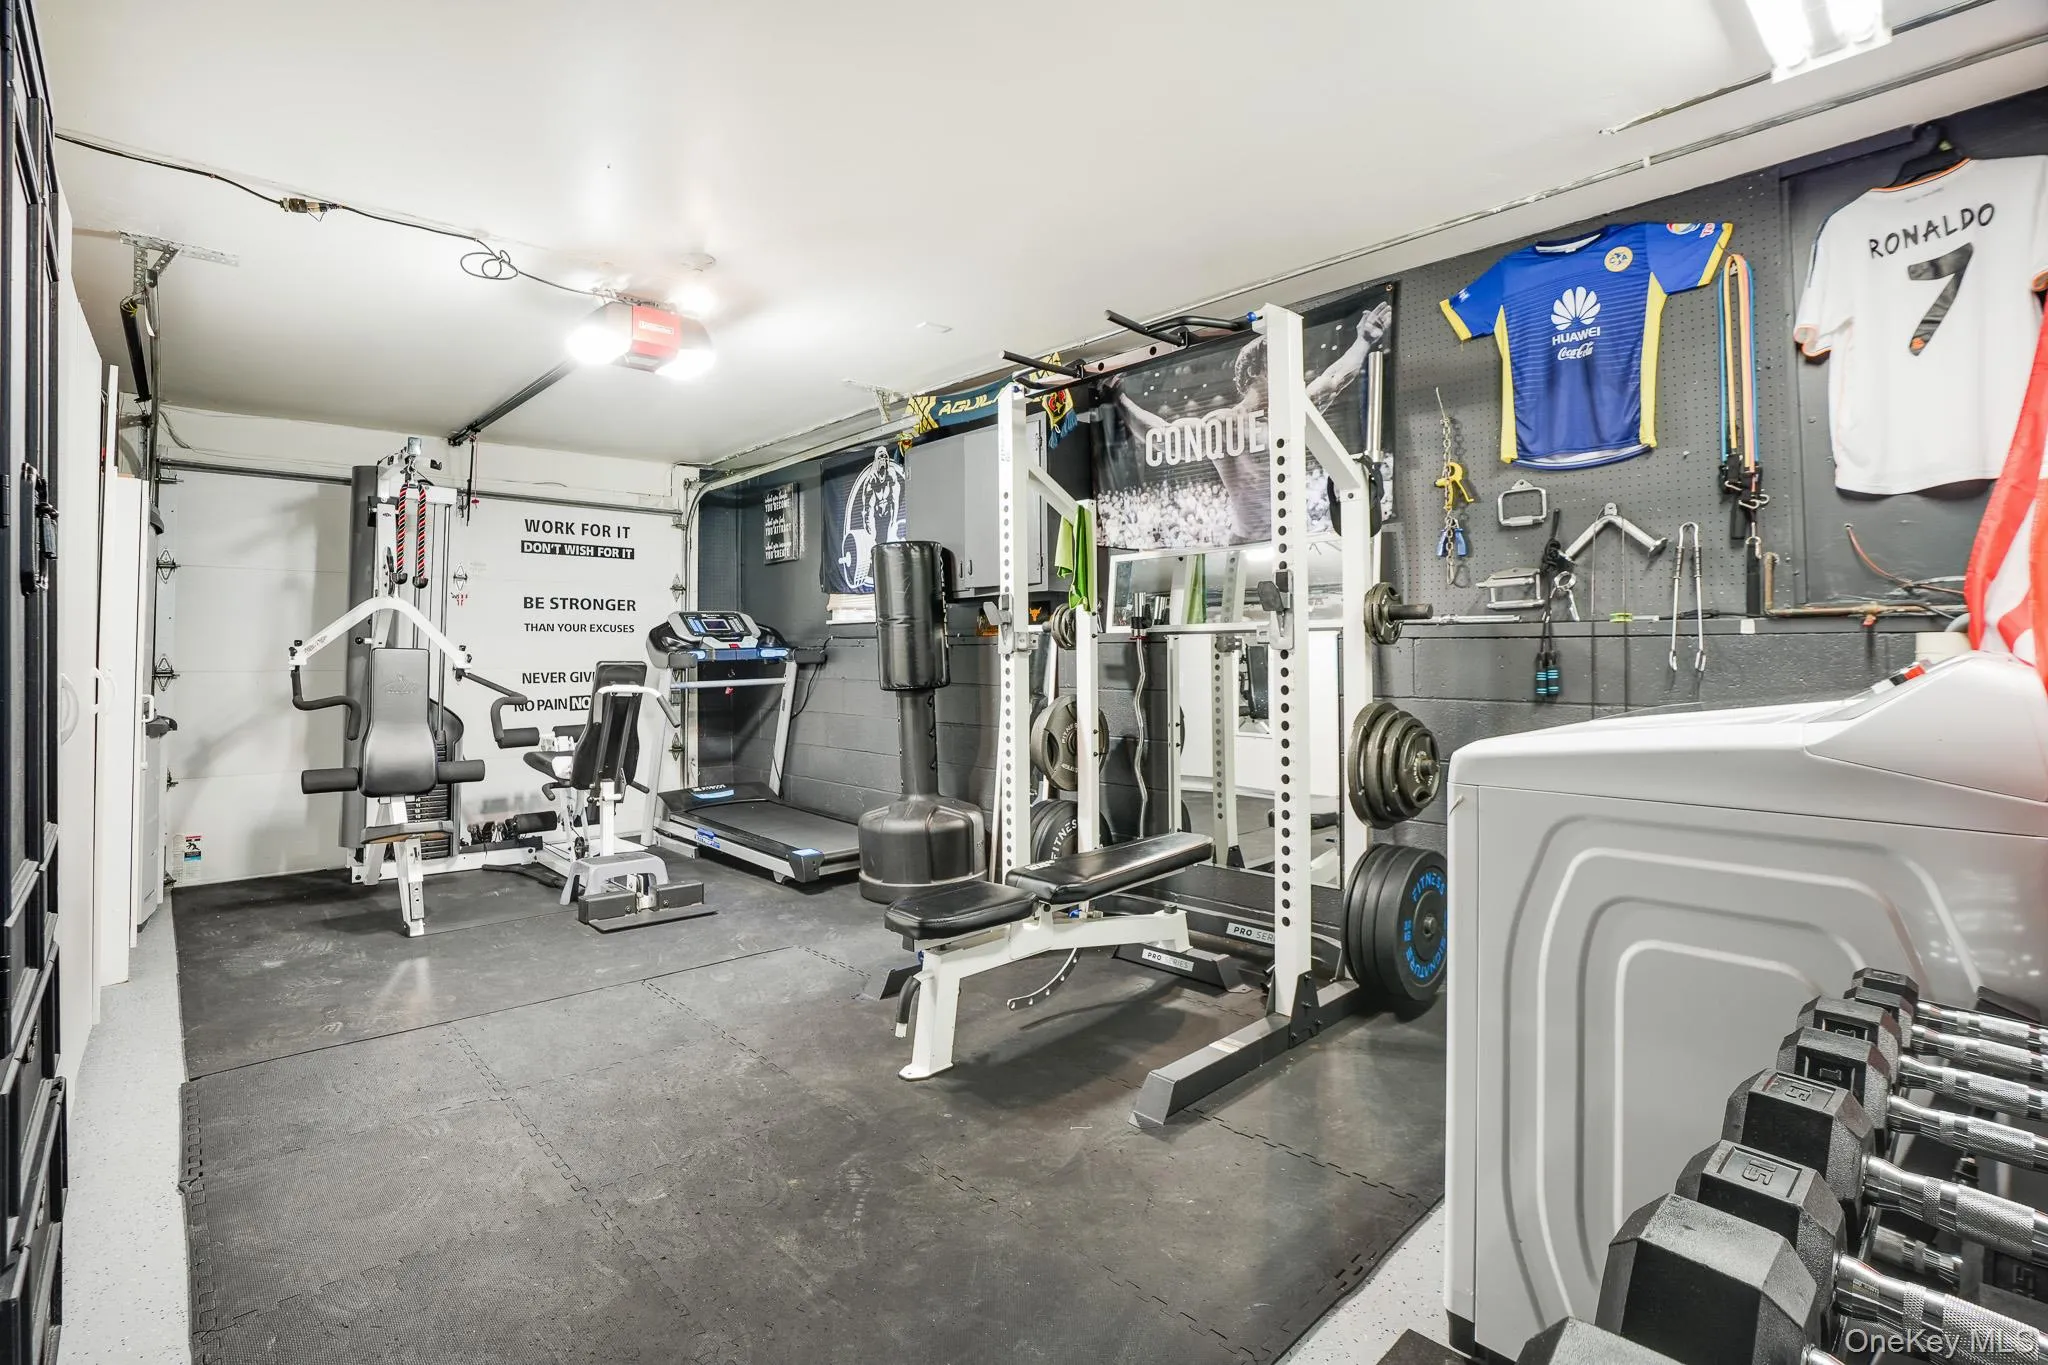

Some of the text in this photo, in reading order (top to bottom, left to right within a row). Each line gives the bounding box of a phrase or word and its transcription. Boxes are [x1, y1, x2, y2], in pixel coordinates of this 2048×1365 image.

[1869, 203, 1995, 259] RONALDO
[1908, 242, 1974, 357] 7
[1552, 326, 1601, 346] HUAWEI
[1145, 409, 1266, 467] CONQUE
[524, 519, 630, 538] WORK FOR IT
[523, 542, 633, 558] DON'T WISH FOR IT
[523, 597, 636, 611] BE STRONGER
[524, 623, 635, 633] THAN YOUR EXCUSES
[522, 672, 566, 684] NEVER
[537, 698, 568, 711] PAIN
[571, 696, 591, 711] NO
[1050, 818, 1078, 861] FITNES
[1234, 926, 1253, 937] PRO
[1147, 951, 1162, 961] PRO
